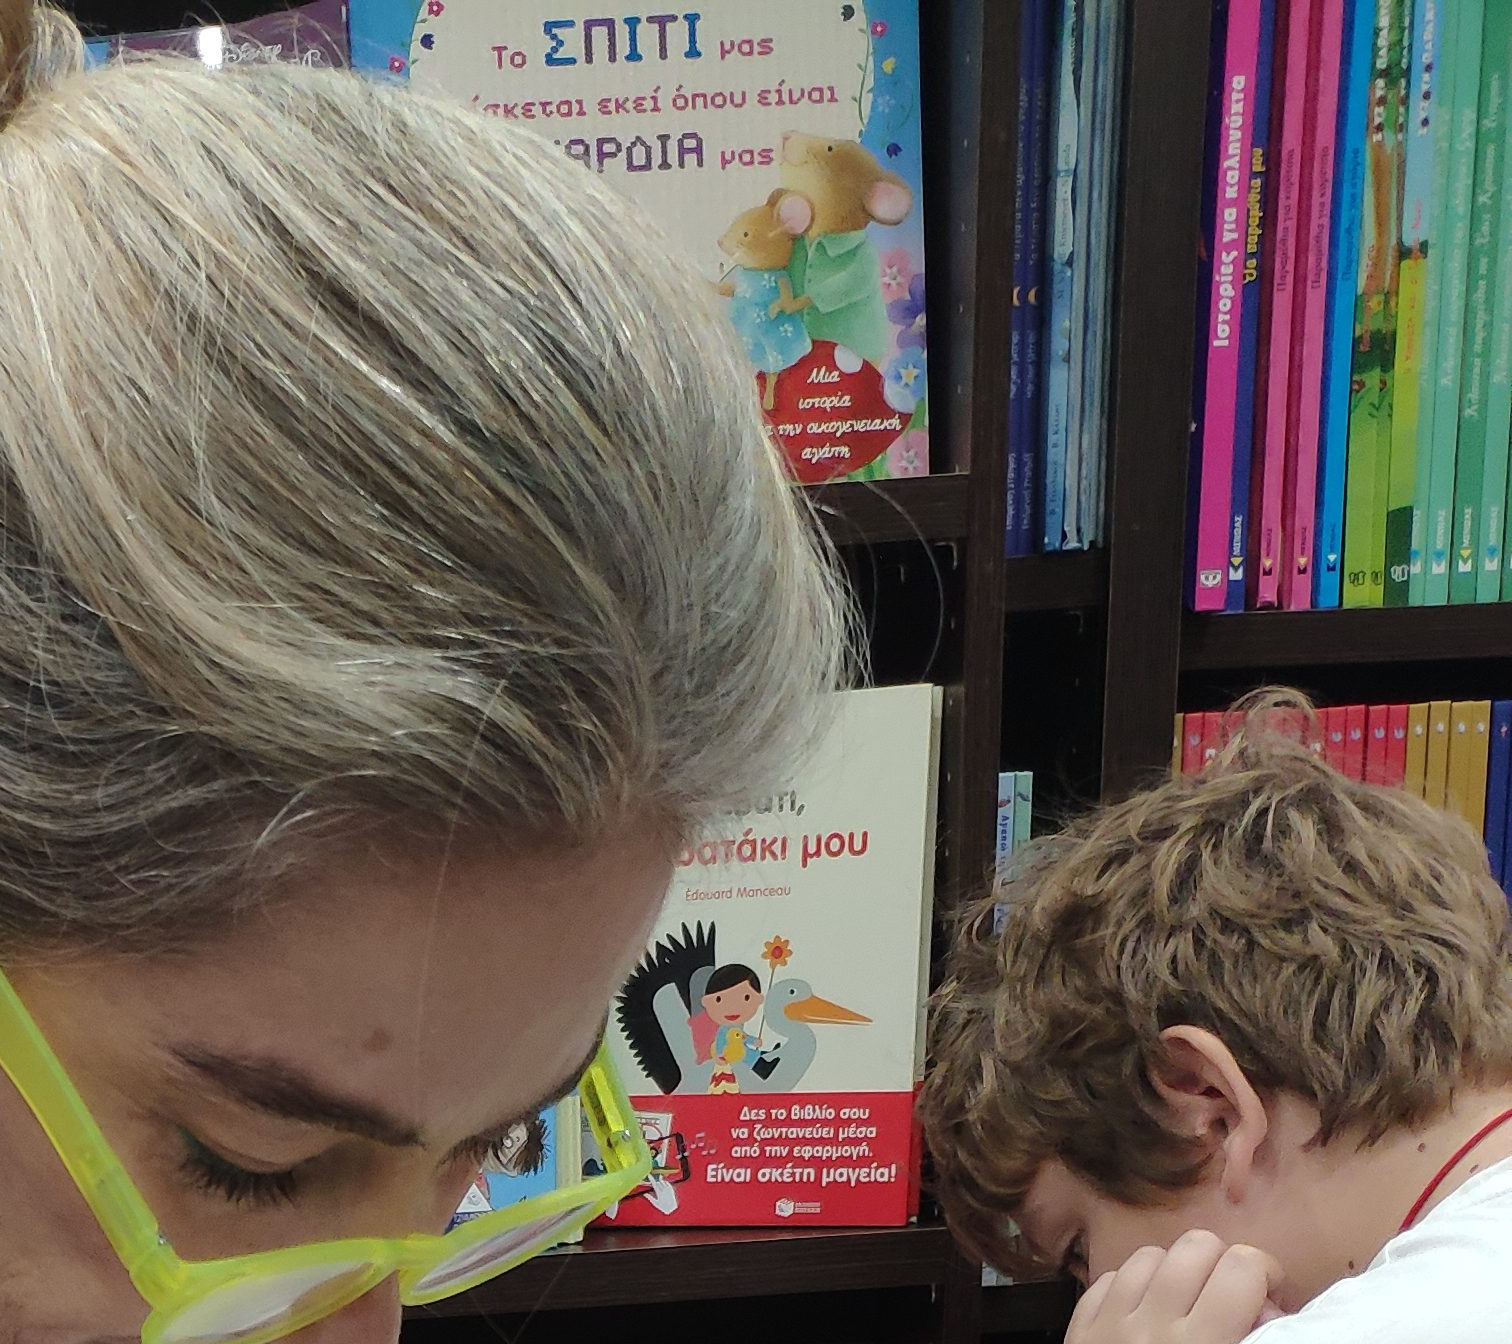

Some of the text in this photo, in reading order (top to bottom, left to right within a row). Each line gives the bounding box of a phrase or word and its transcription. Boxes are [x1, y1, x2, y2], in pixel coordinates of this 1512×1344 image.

[492, 12, 774, 70] Το ΣΠΙΤΙ μας
[472, 80, 839, 119] σκεται εκεί όπου είναι
[554, 132, 774, 174] ΑΡΔΙΑ μας
[1252, 148, 1266, 172] μου
[1222, 207, 1238, 243] για
[1213, 250, 1238, 347] Ιστορίες
[807, 366, 840, 384] Μια
[798, 392, 852, 412] ιστορία
[778, 423, 802, 437] την
[807, 414, 902, 437] οικογενειακή
[801, 443, 851, 464] αγάπη
[801, 830, 869, 869] μου
[736, 885, 791, 899] Manceau
[739, 1104, 869, 1120] Δες το βιβλίο σου
[731, 1123, 876, 1141] να ζωντανεύει μέσα
[731, 1142, 873, 1161] από την εφαρμογή.
[706, 1162, 897, 1187] Είναι σκέτη μαγεία!
